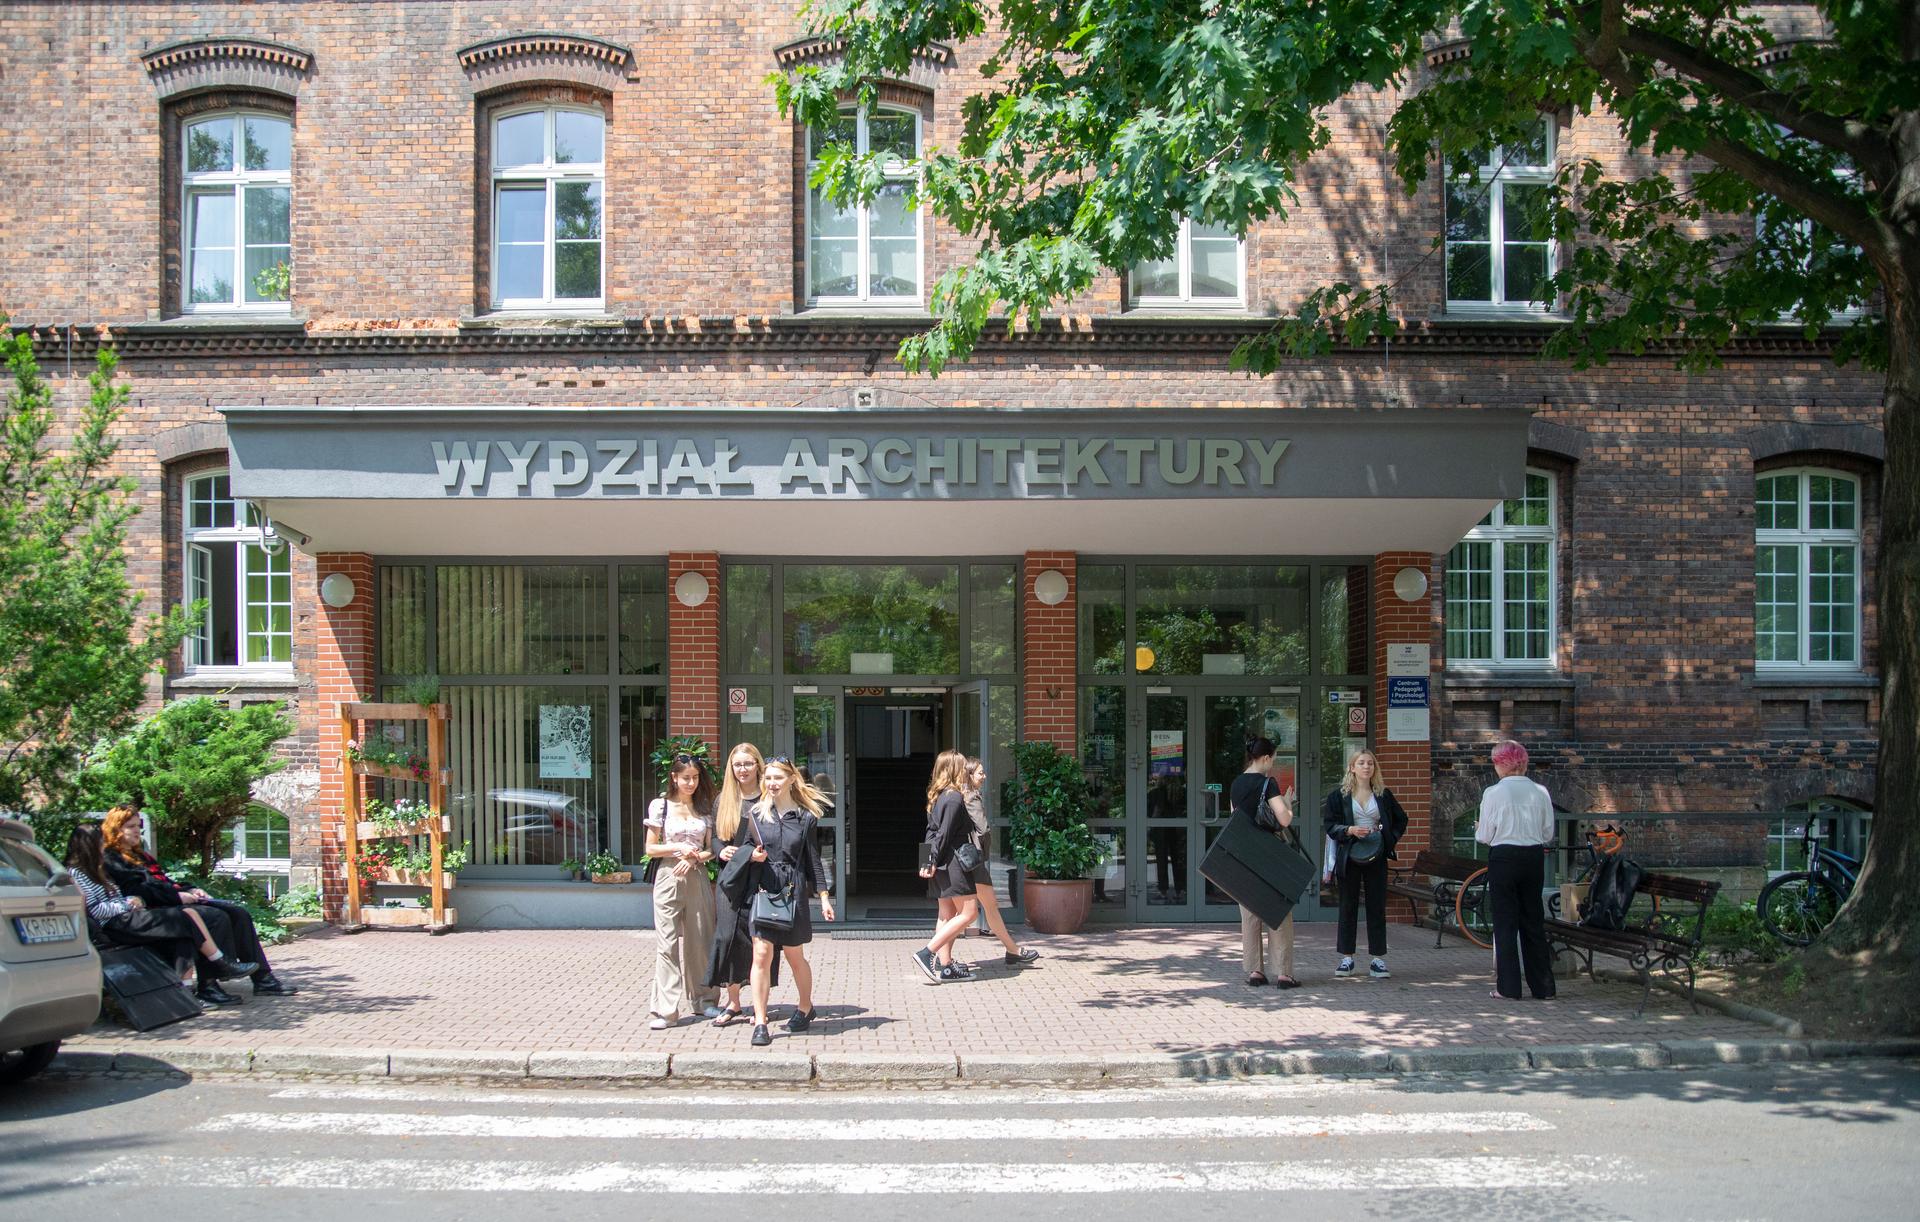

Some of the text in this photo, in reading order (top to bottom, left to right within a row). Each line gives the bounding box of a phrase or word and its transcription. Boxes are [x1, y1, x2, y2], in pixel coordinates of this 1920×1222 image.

[431, 438, 1291, 486] WYDZIAŁ ARCHITEKTURY
[24, 919, 41, 936] KR
